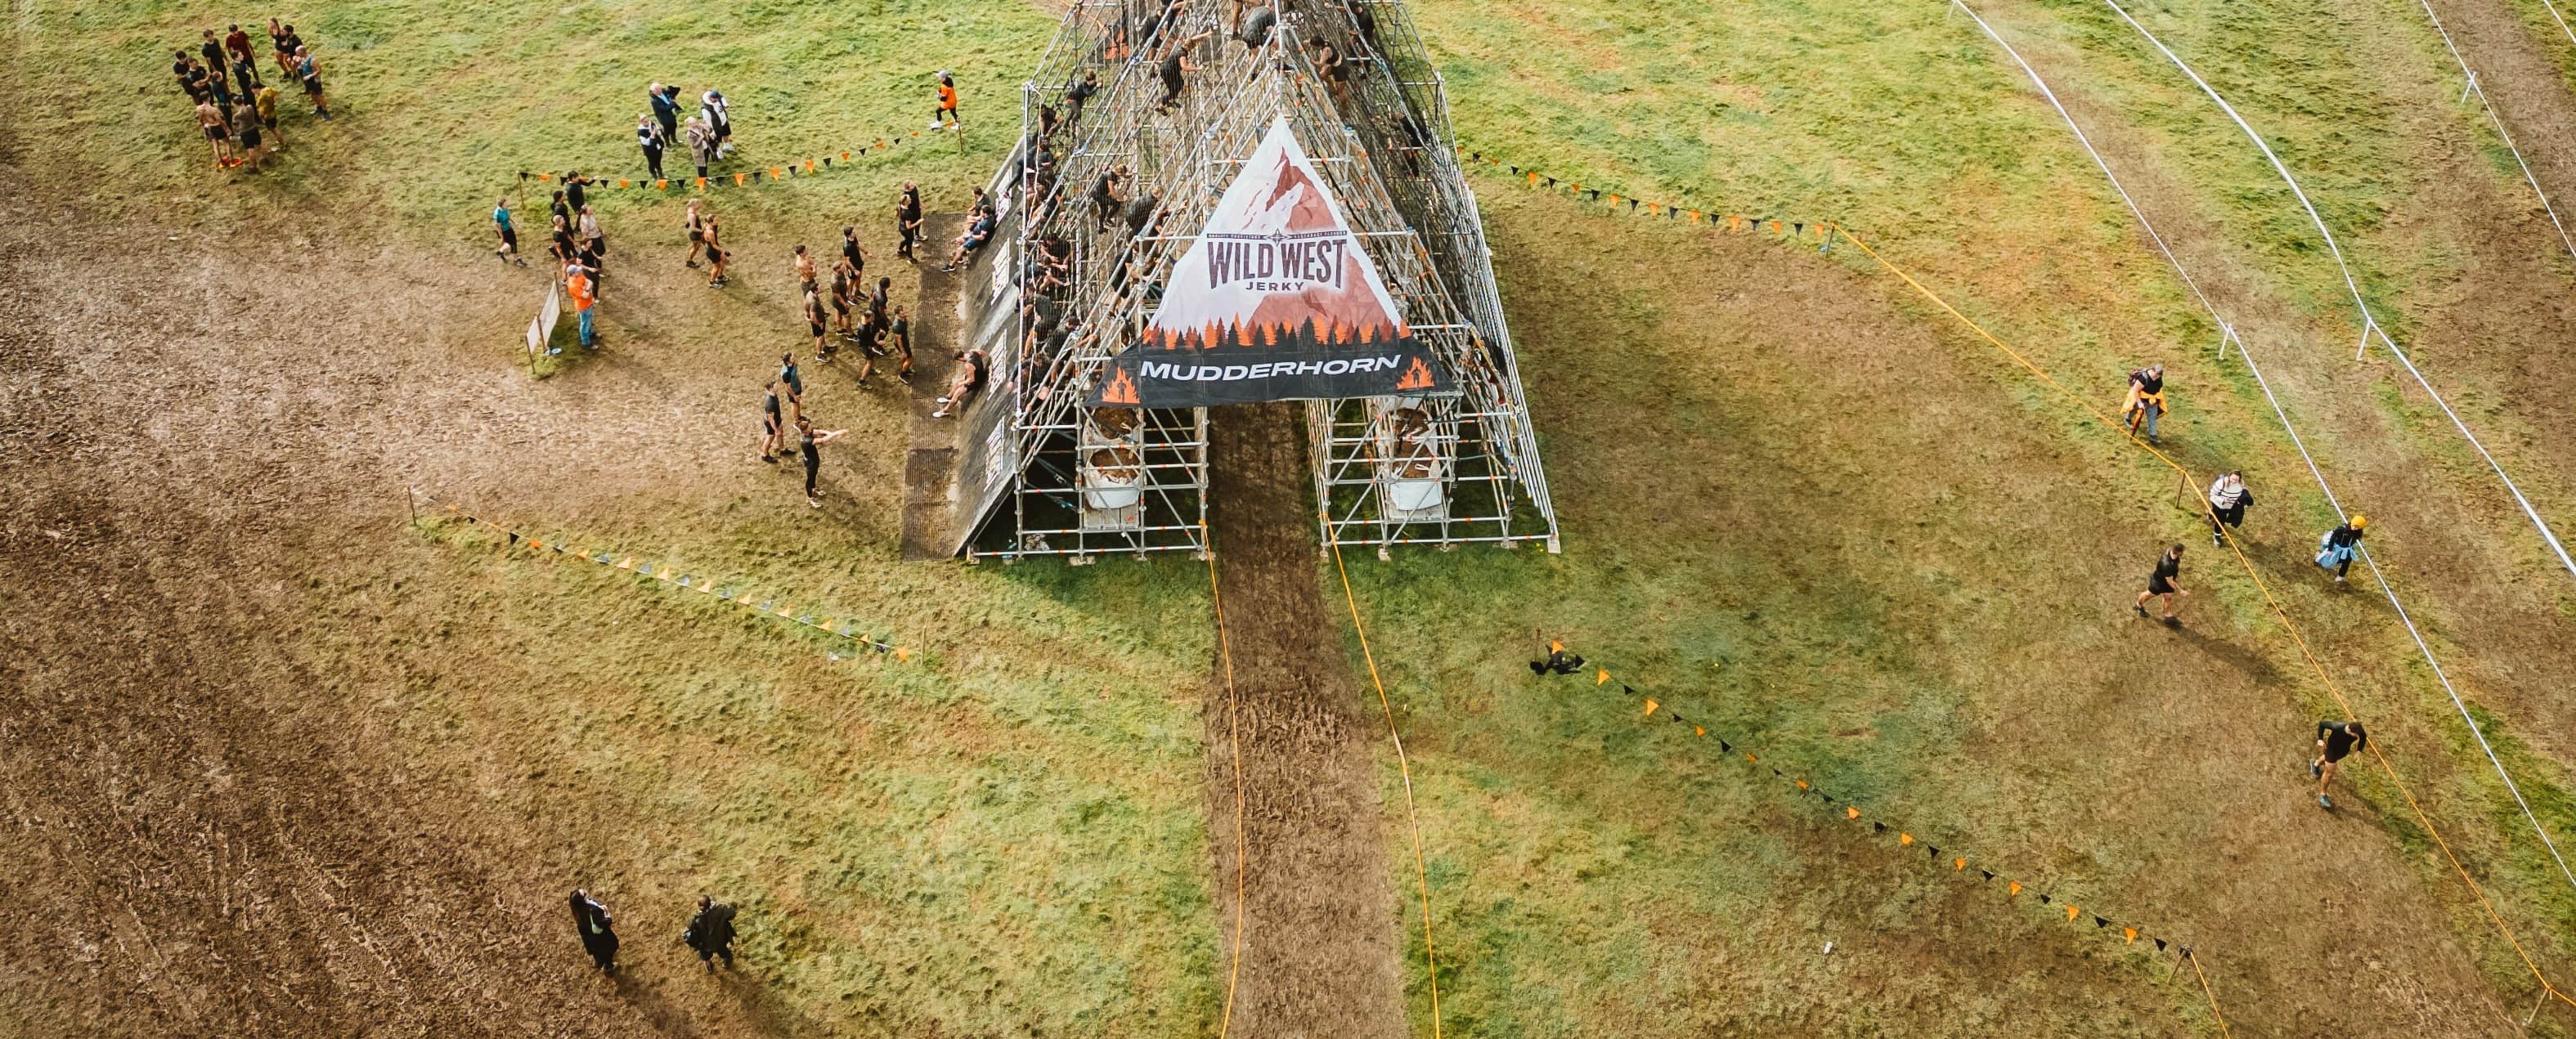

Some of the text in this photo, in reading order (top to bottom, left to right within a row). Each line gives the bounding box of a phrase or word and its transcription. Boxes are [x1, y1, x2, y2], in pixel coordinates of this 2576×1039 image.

[1207, 239, 1348, 289] WILD WEST
[1245, 281, 1304, 291] JERKY
[1140, 354, 1402, 381] MUDDERHORN
